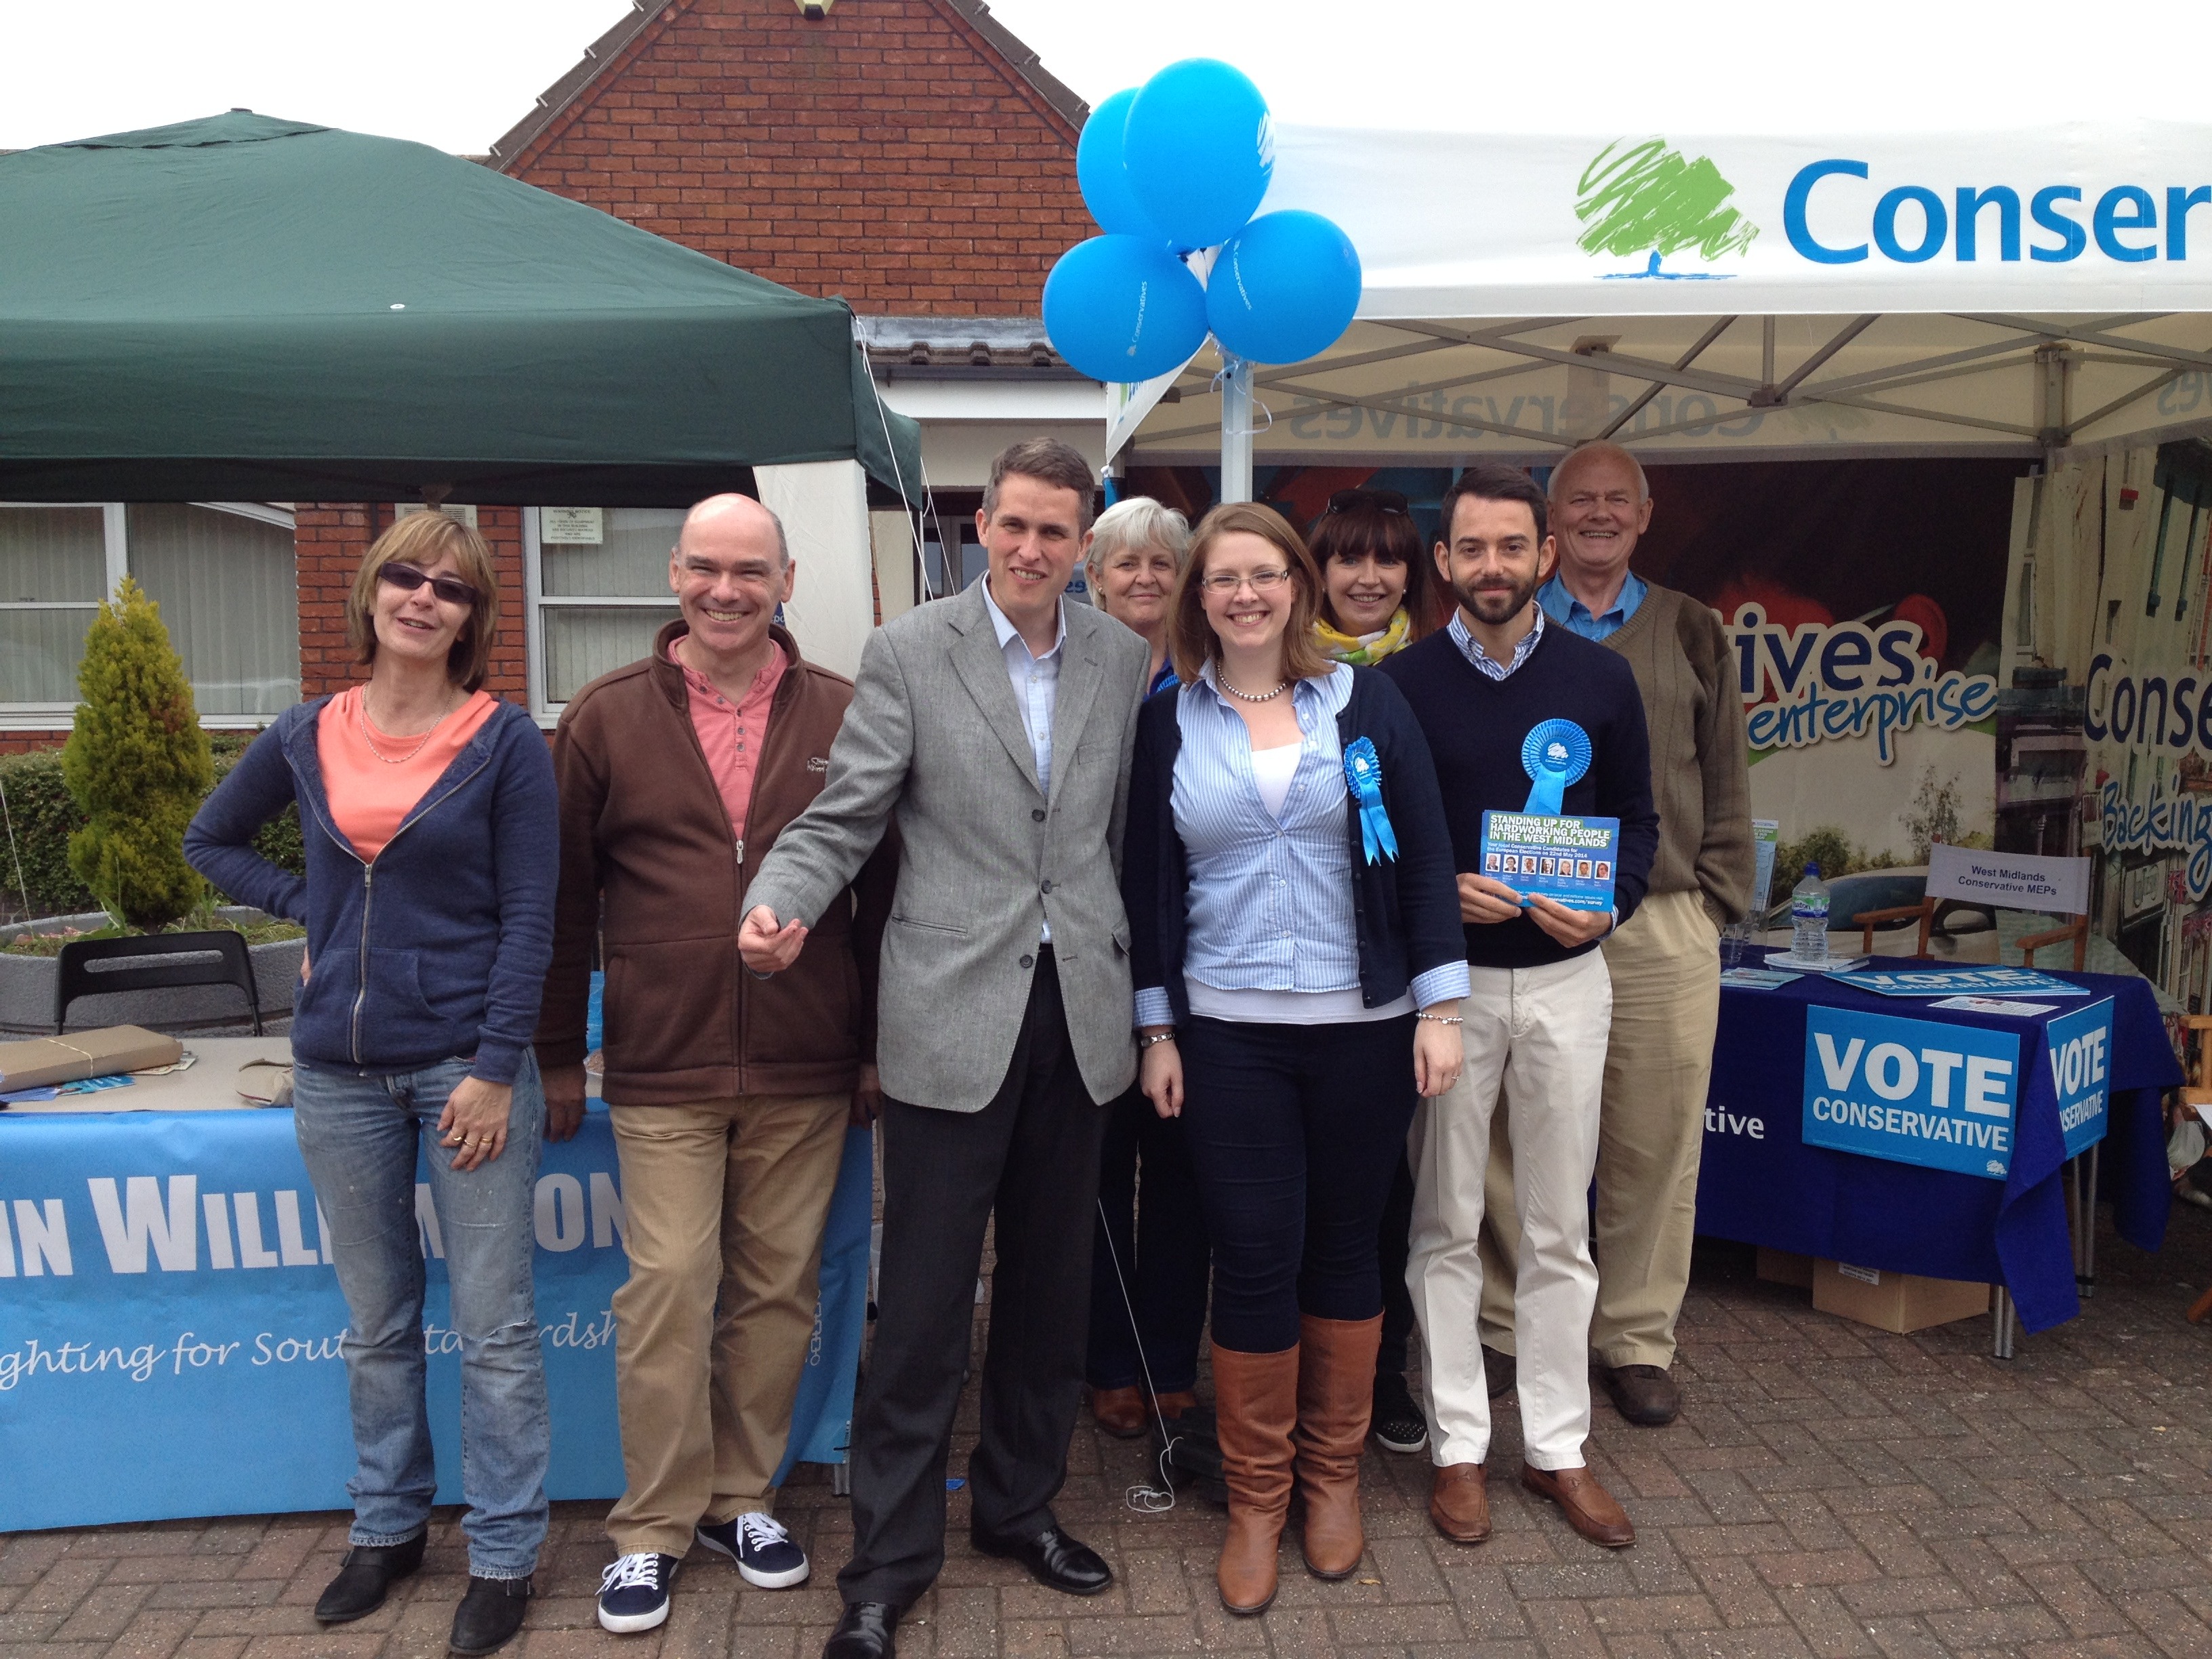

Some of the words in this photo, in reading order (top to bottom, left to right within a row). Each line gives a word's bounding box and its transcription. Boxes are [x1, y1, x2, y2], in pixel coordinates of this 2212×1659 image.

[1784, 158, 2212, 264] Conser
[1233, 251, 1252, 311] Conservatives
[1132, 281, 1147, 343] Conservatives
[1748, 664, 1998, 761] enterprise
[2083, 653, 2212, 750] Conse
[1489, 831, 1500, 840] IN
[1502, 832, 1521, 842] THE
[1523, 834, 1552, 844] WEST
[1553, 836, 1607, 848] MIDLANDS
[1490, 815, 1541, 827] STANDING
[1543, 818, 1558, 827] UP
[1559, 819, 1581, 830] FOR
[1490, 823, 1568, 837] HARDWORKING
[1570, 828, 1610, 840] PEOPLE
[2104, 774, 2212, 894] Backing
[1958, 876, 2025, 893] Conservative
[2026, 884, 2057, 896] MEPs
[1971, 865, 1997, 878] West
[1999, 869, 2046, 882] Midlands
[1842, 970, 2022, 985] VOTE
[1875, 978, 2056, 990] CONSERVATIVE
[1814, 1032, 2013, 1118] VOTE
[2049, 1025, 2107, 1101] VOTE
[1812, 1096, 2009, 1152] CONSERVATIVE
[2059, 1089, 2104, 1133] NSERVATIVE
[172, 1332, 240, 1374] for
[251, 1329, 348, 1366] Sout
